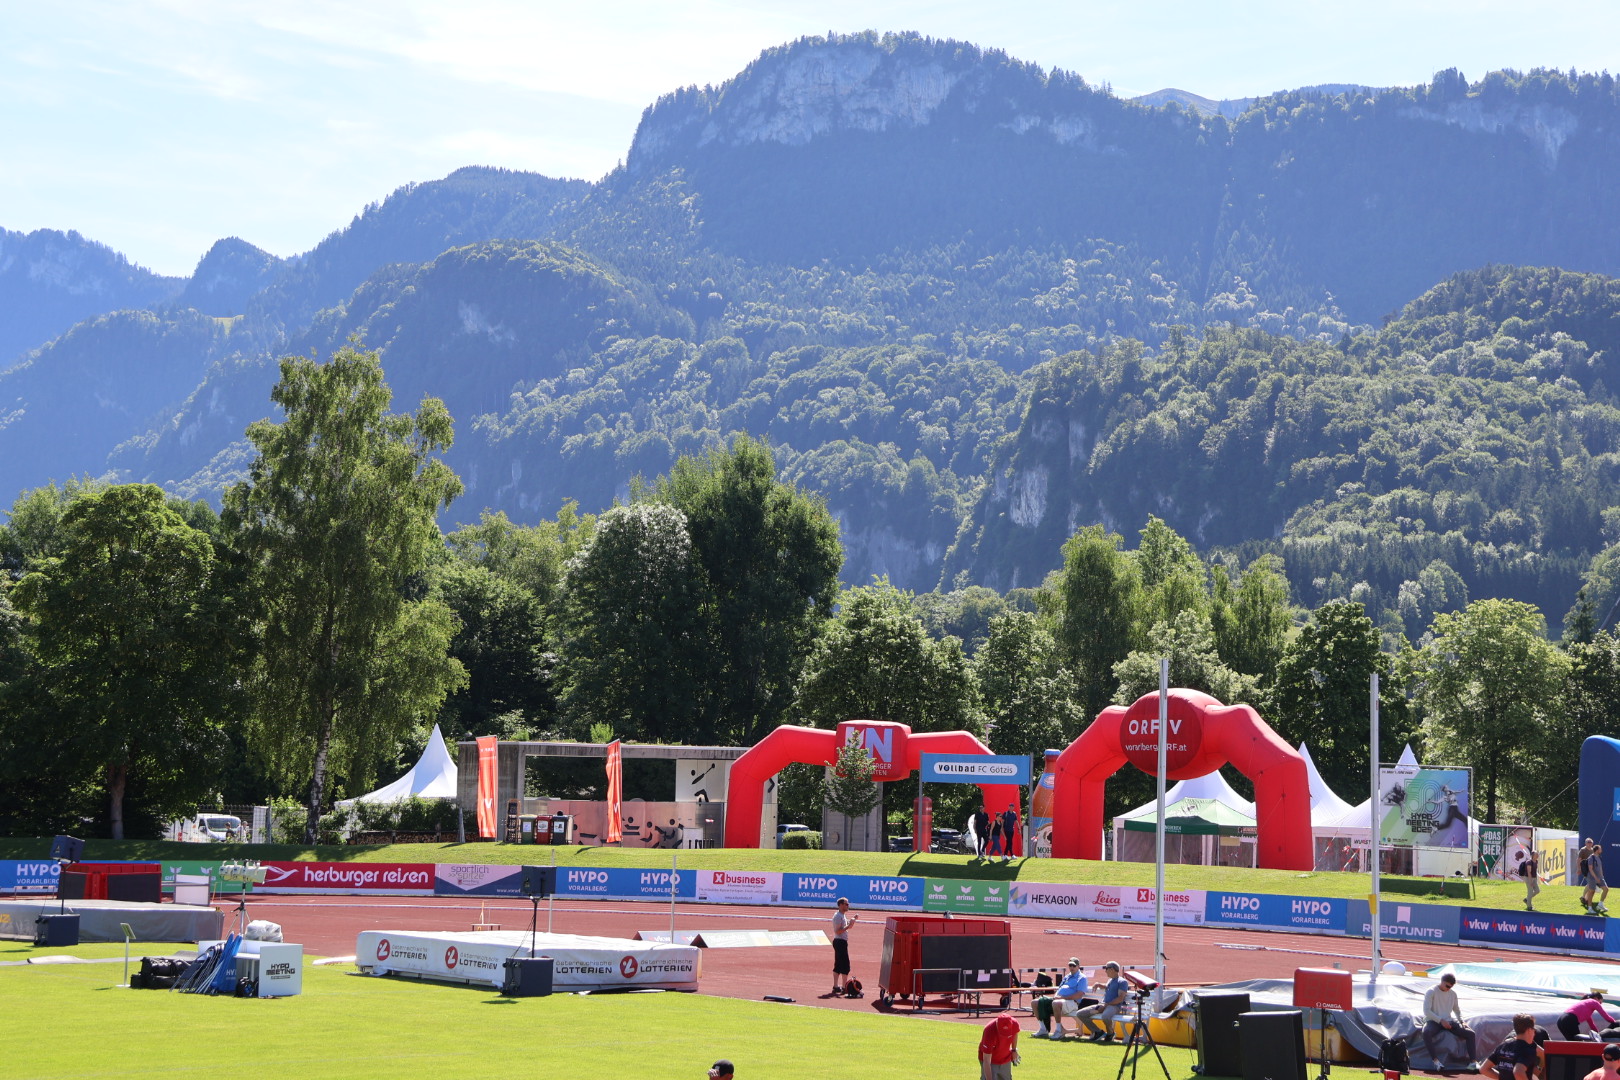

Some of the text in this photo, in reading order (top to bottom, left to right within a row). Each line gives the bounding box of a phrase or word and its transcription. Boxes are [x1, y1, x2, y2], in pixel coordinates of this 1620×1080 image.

[1128, 719, 1183, 735] ORF V
[977, 765, 987, 773] FC
[989, 765, 1013, 774] Götzis
[16, 863, 61, 876] HYPO
[304, 866, 428, 886] herburger reisen
[568, 871, 608, 883] HYPO
[640, 872, 681, 885] HYPO
[726, 874, 766, 884] business
[798, 877, 838, 890] HYPO
[869, 880, 908, 893] HYPO
[798, 891, 836, 899] VORARLBERG
[869, 894, 907, 902] VORARLBERG
[1031, 894, 1077, 905] HEXAGON
[1092, 890, 1120, 905] Leica
[1221, 896, 1260, 910] HYPO
[1291, 900, 1331, 915] HYPO
[1221, 911, 1259, 920] VORARLBERG
[1291, 916, 1330, 925] VORARLBERG
[1469, 919, 1489, 930] vkw
[1497, 921, 1517, 933] vkw
[1525, 923, 1546, 935] vkw
[1555, 925, 1576, 938] vkw
[1584, 928, 1605, 940] vkw
[391, 950, 428, 960] LOTTERIEN
[459, 959, 498, 970] LOTTERIEN
[640, 965, 692, 973] LOTTERIEN
